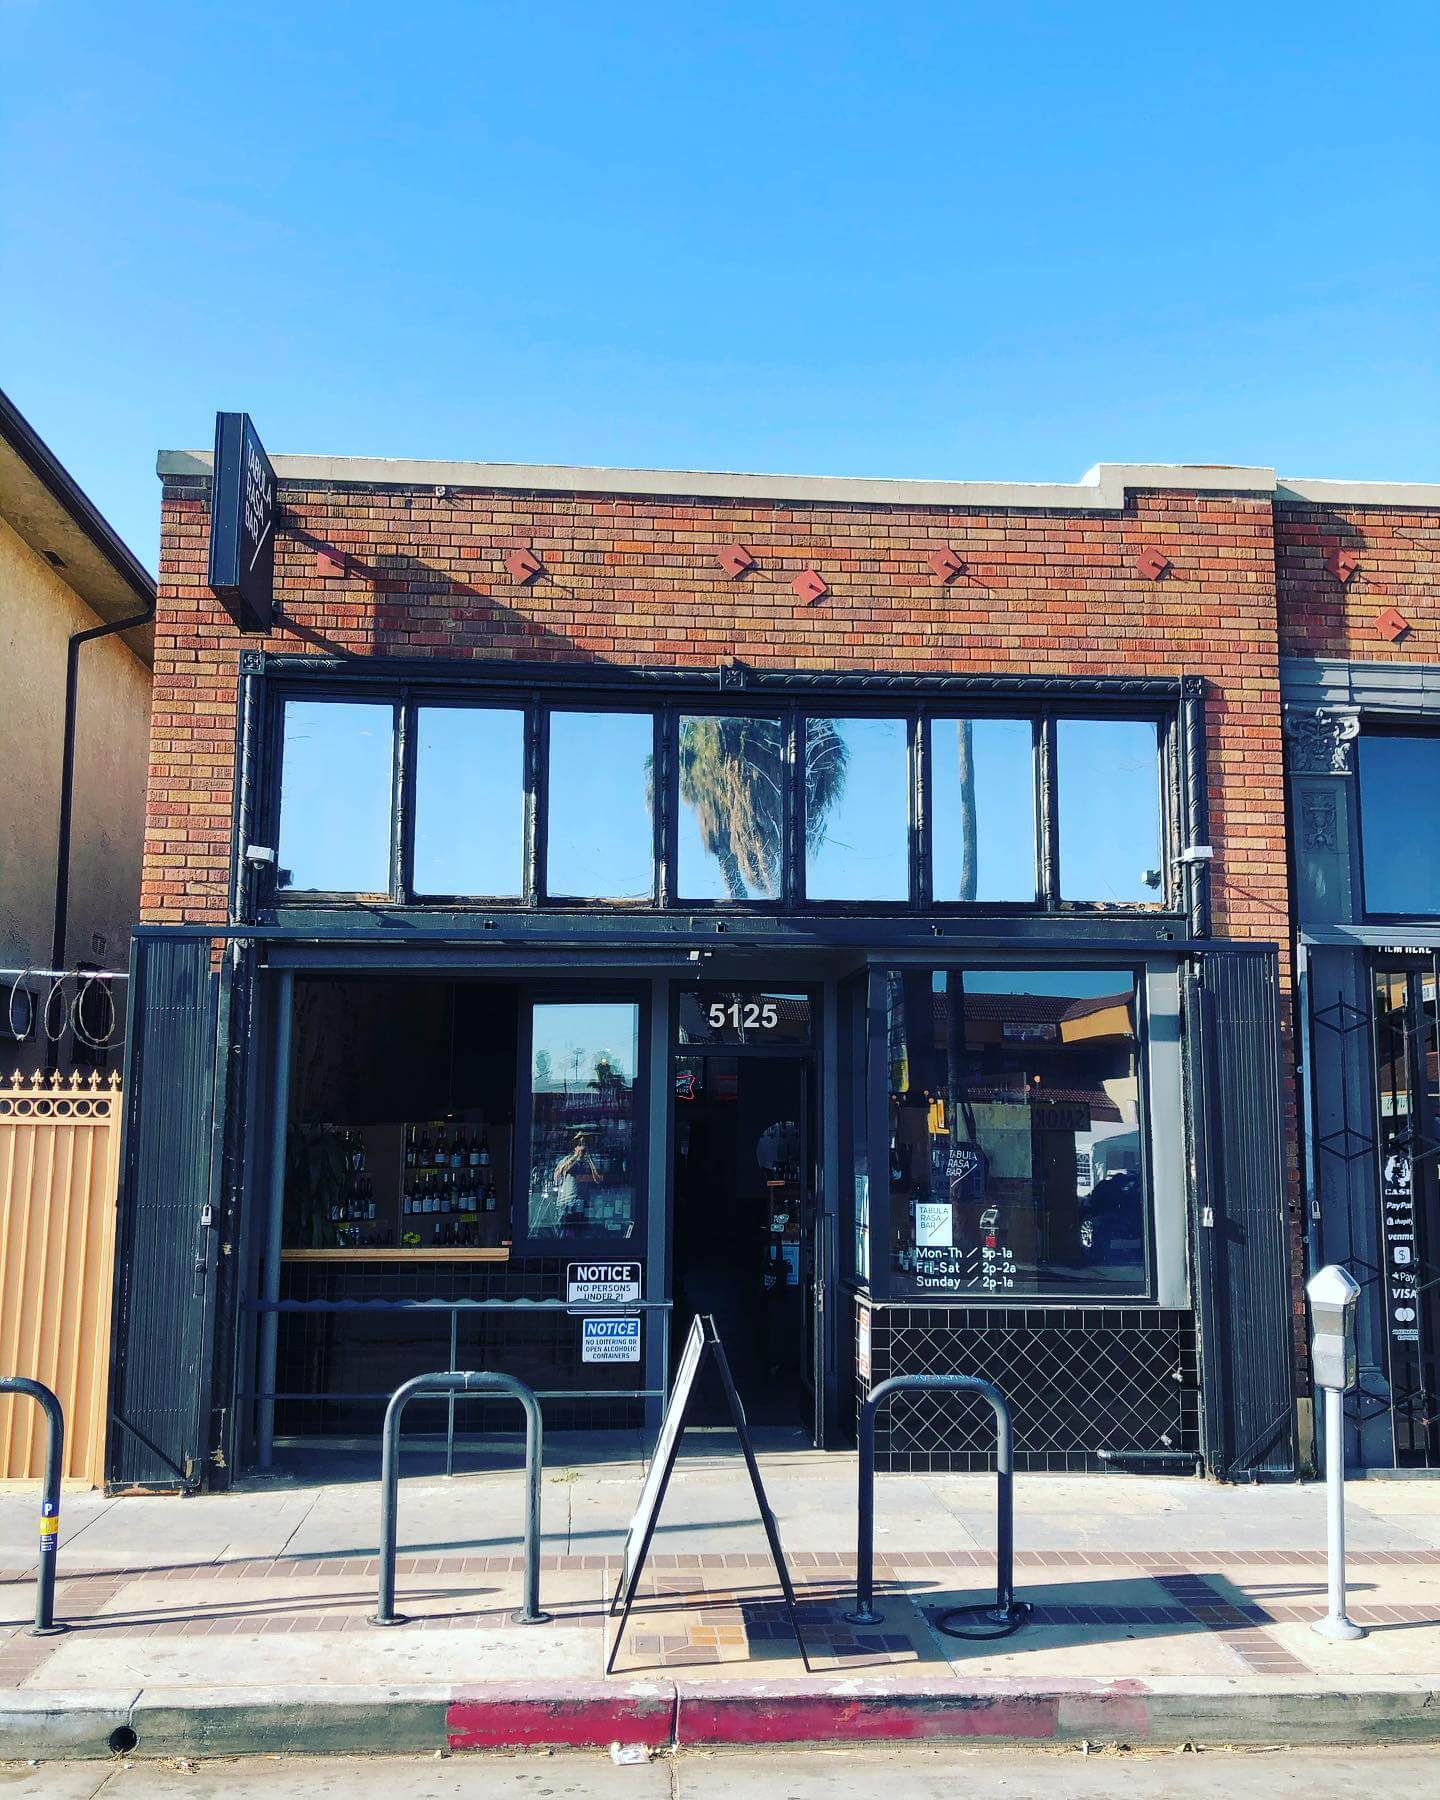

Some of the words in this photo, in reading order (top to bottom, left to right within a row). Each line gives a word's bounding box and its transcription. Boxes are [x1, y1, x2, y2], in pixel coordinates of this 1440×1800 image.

[248, 439, 272, 510] TABULA
[247, 472, 264, 526] RASA
[245, 501, 258, 545] BAR
[708, 1003, 778, 1028] 5125
[949, 1149, 978, 1161] TABULA
[947, 1159, 970, 1169] RASA
[945, 1168, 963, 1177] BAR
[919, 1207, 949, 1215] TABULA
[920, 1214, 941, 1222] RASA
[916, 1247, 963, 1259] Mon-Th
[982, 1247, 1013, 1261] 5p-1a
[577, 1266, 631, 1281] NOTICE
[916, 1262, 961, 1273] Fri-Sat
[982, 1262, 1017, 1275] 2p-2a
[916, 1276, 961, 1289] Sunday
[982, 1276, 1014, 1289] 2p-1a
[1399, 1271, 1416, 1284] Pay
[576, 1284, 590, 1292] NO
[592, 1284, 631, 1292] PERSONS
[1392, 1288, 1418, 1299] VISA
[587, 1322, 637, 1336] NOTICE
[604, 1345, 637, 1353] ALCOHOLIC
